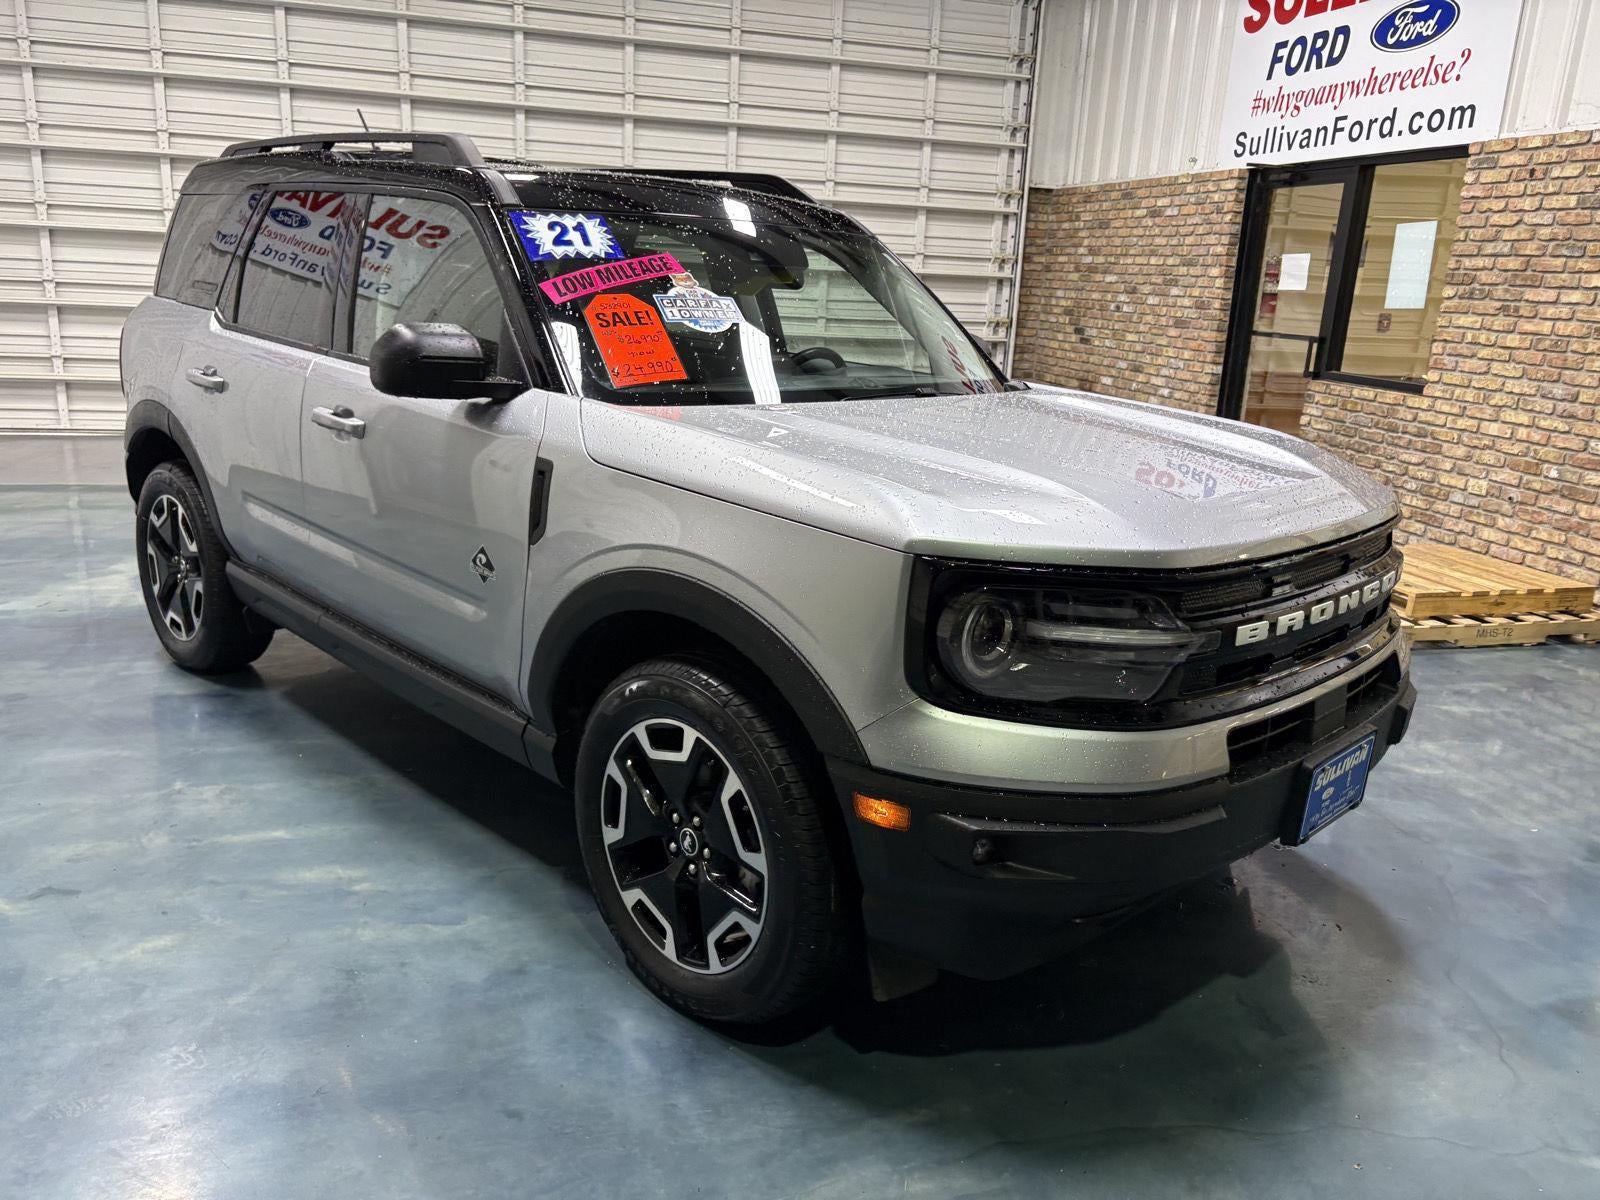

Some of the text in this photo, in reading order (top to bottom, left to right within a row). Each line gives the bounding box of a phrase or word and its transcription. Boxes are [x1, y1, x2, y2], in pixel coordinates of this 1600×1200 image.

[1387, 5, 1443, 44] Ford
[1266, 25, 1351, 80] FORD
[1251, 48, 1472, 119] #whygoanywhereelse?
[1233, 102, 1477, 158] SullivanFord.com
[547, 221, 593, 247] 21
[552, 256, 674, 297] LOW MILEAGE
[595, 310, 654, 328] SALE!
[662, 299, 733, 310] CARFAX
[1235, 570, 1397, 647] BRONCO
[1475, 627, 1514, 639] MHS-T2
[1313, 744, 1369, 792] SULLIVAN
